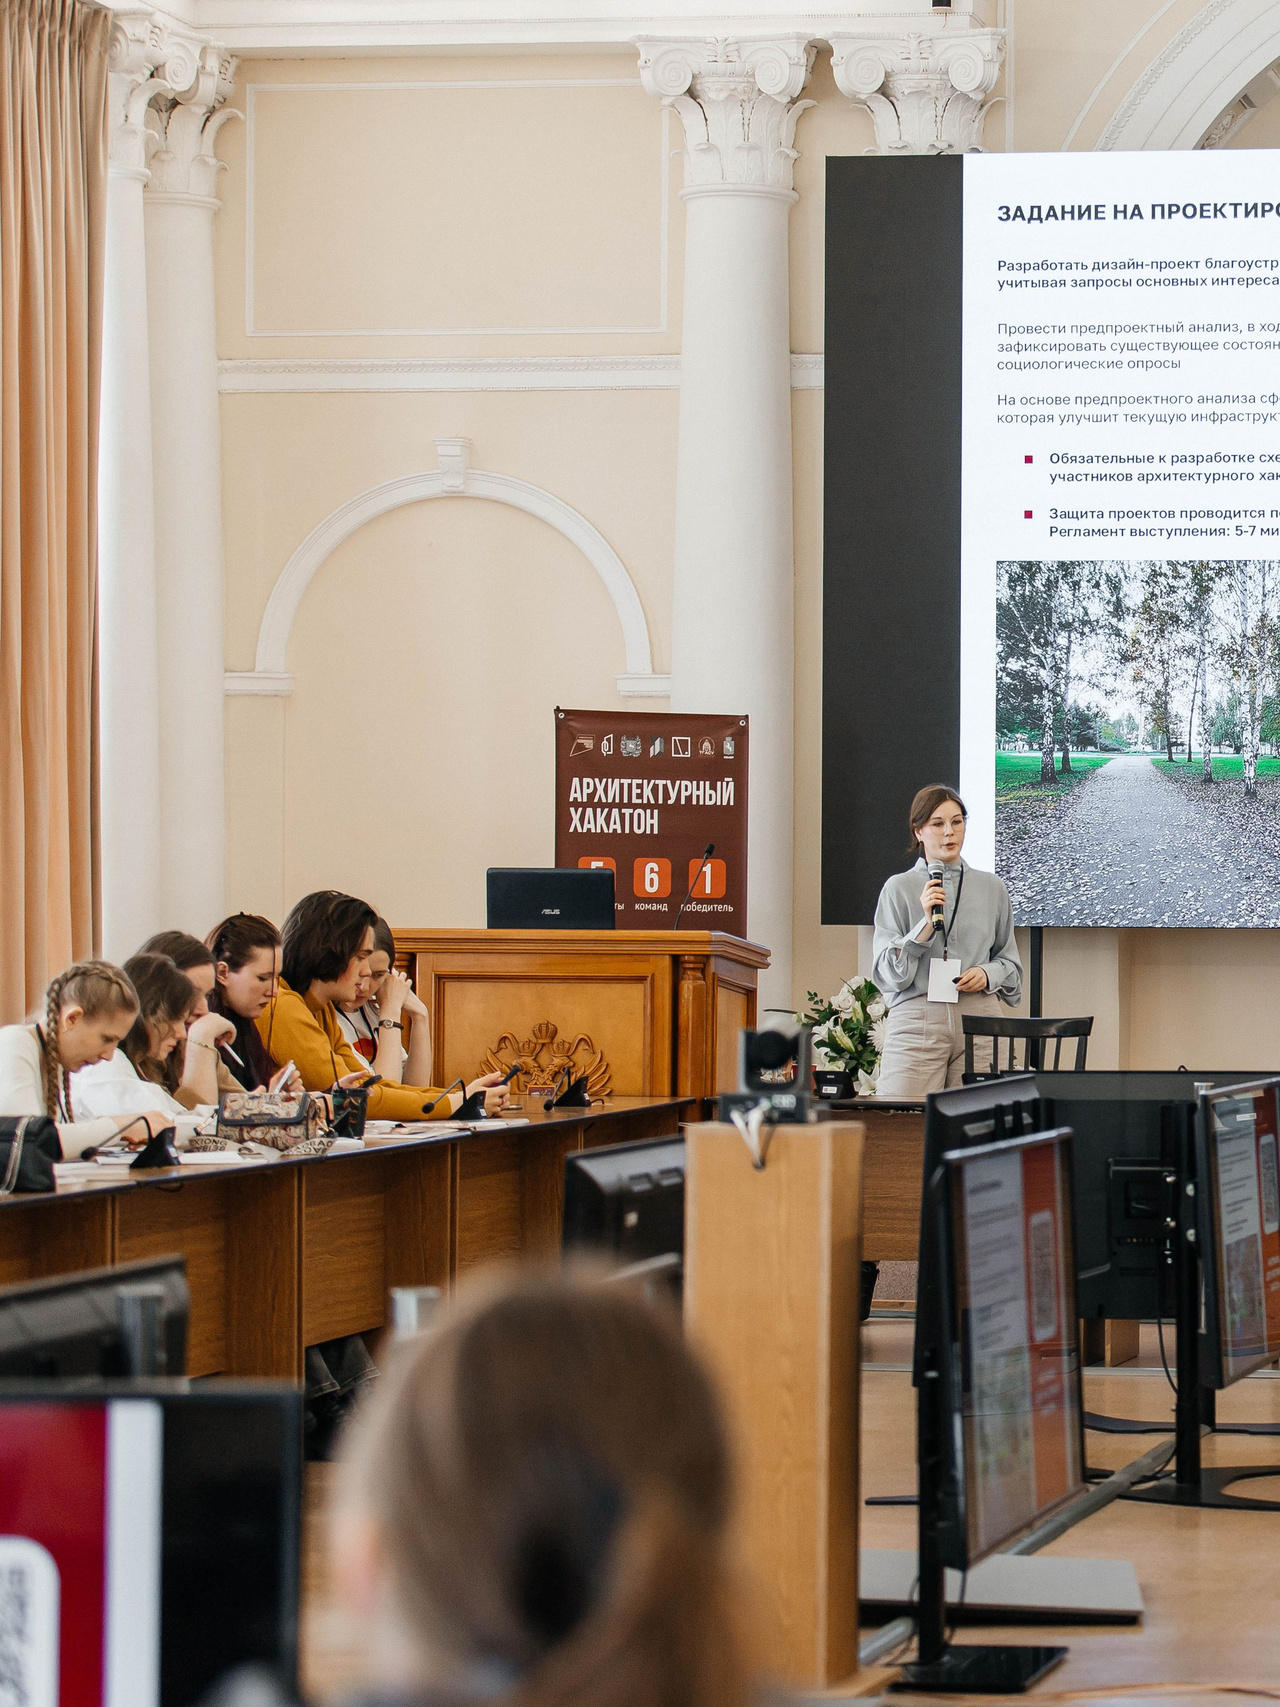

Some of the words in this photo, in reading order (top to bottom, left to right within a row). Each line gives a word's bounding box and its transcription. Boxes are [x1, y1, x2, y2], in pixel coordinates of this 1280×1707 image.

[997, 205, 1106, 224] ЗАДАНИЕ
[1113, 203, 1144, 220] НА
[997, 259, 1088, 274] Разработать
[1091, 257, 1201, 272] дизайн-проект
[996, 278, 1066, 292] учитывая
[1070, 277, 1132, 290] запросы
[1135, 277, 1207, 287] основных
[997, 322, 1066, 337] Провести
[1070, 320, 1184, 337] предпроектный
[1187, 322, 1243, 334] анализ,
[1247, 322, 1255, 332] в
[996, 340, 1107, 355] зафиксировать
[1109, 340, 1219, 354] существующее
[996, 359, 1124, 372] социологические
[1126, 359, 1181, 372] опросы
[997, 393, 1016, 406] На
[1019, 395, 1071, 406] основе
[1074, 394, 1193, 408] предпроектного
[1196, 394, 1256, 404] анализа
[996, 413, 1054, 426] которая
[1058, 413, 1119, 426] улучшит
[1122, 412, 1187, 425] текущую
[1049, 451, 1155, 464] Обязательные
[1158, 454, 1166, 463] к
[1170, 451, 1255, 466] разработке
[1049, 472, 1133, 485] участников
[1136, 471, 1255, 484] архитектурного
[1049, 507, 1104, 521] Защита
[1108, 509, 1176, 522] проектов
[1179, 509, 1265, 522] проводится
[1049, 525, 1126, 537] Регламент
[1129, 527, 1230, 540] выступления:
[1234, 524, 1256, 537] 5-7
[568, 777, 735, 806] АРХИТЕКТУРНЫЙ
[568, 807, 659, 834] ХАКАТОН
[644, 862, 659, 894] 6
[702, 863, 712, 895] 1
[634, 902, 669, 912] команд
